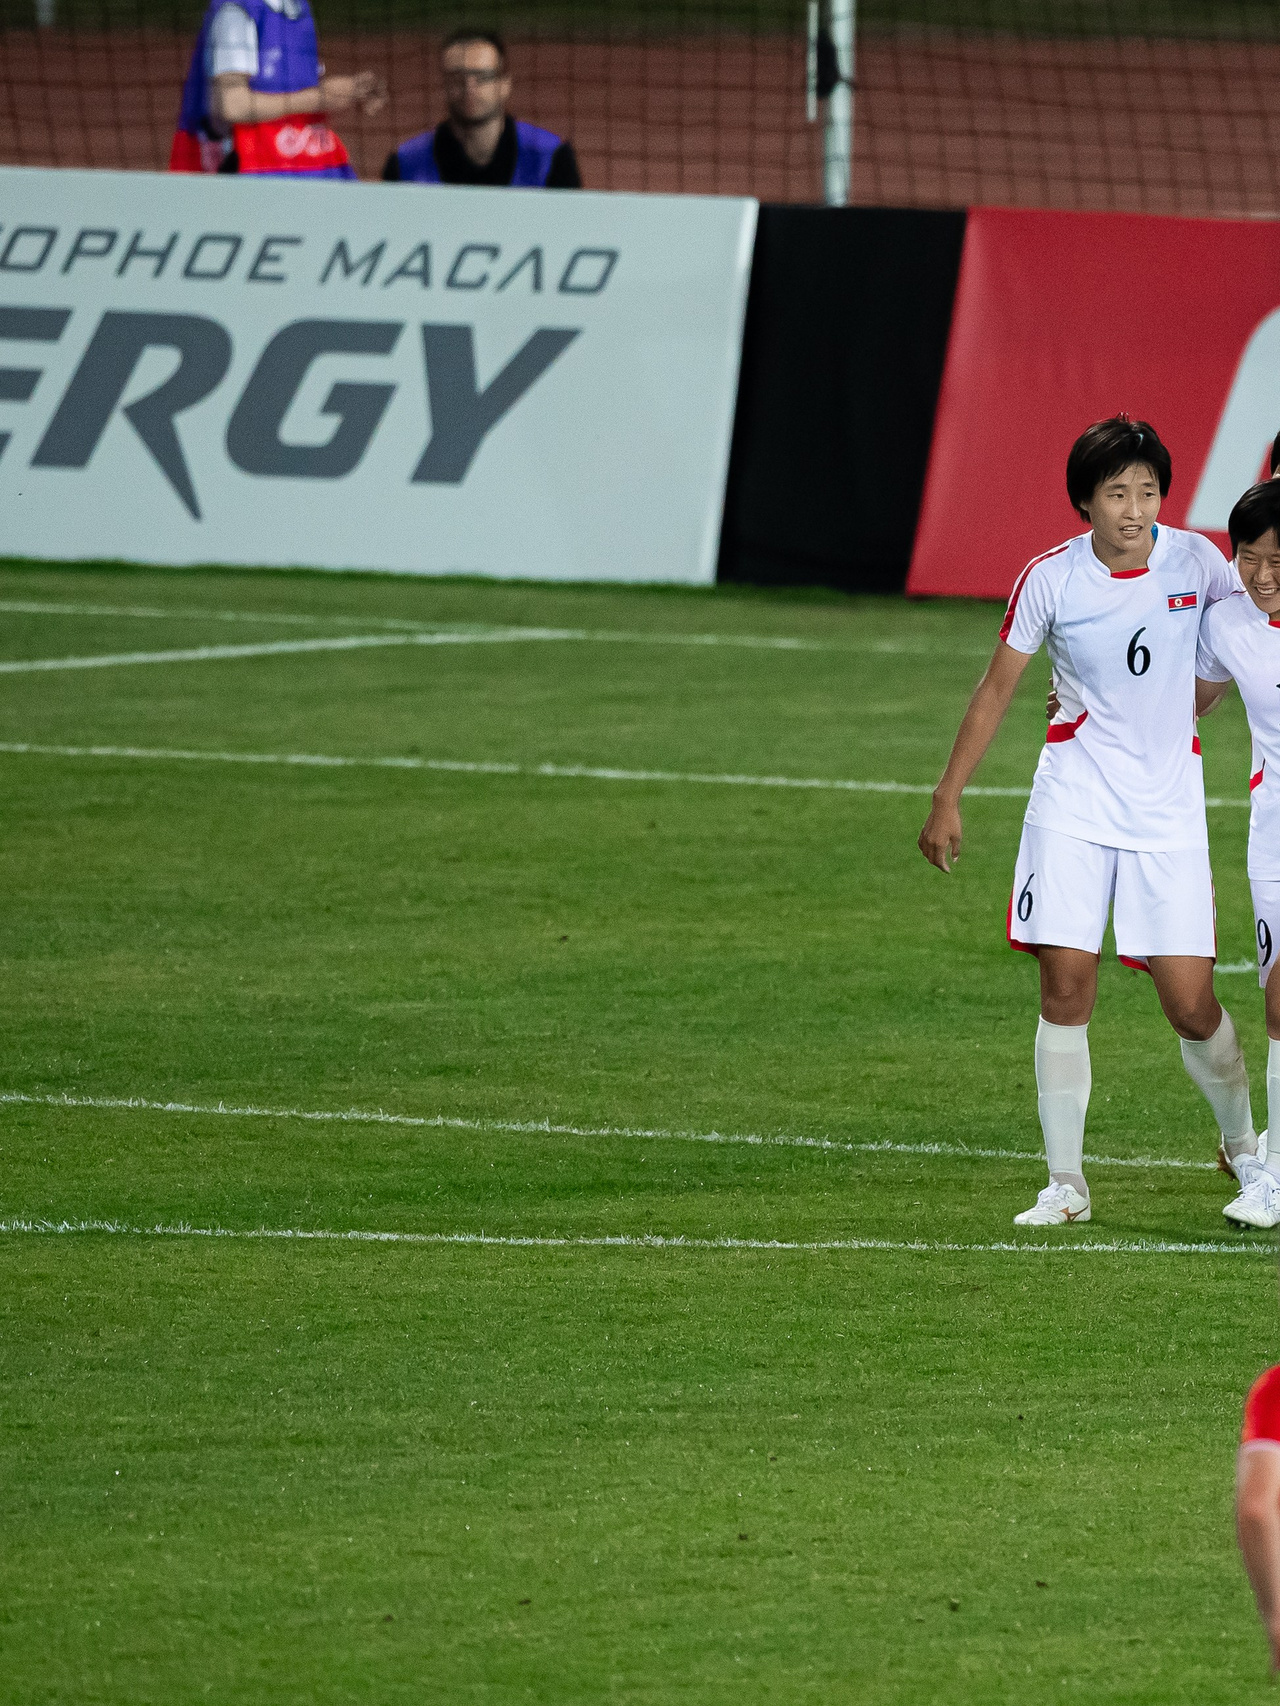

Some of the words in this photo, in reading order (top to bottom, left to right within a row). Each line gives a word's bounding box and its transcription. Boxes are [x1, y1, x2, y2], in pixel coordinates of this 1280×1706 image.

[0, 223, 304, 285] ОРНОЕ
[1126, 626, 1151, 677] 6
[1017, 872, 1035, 923] 6
